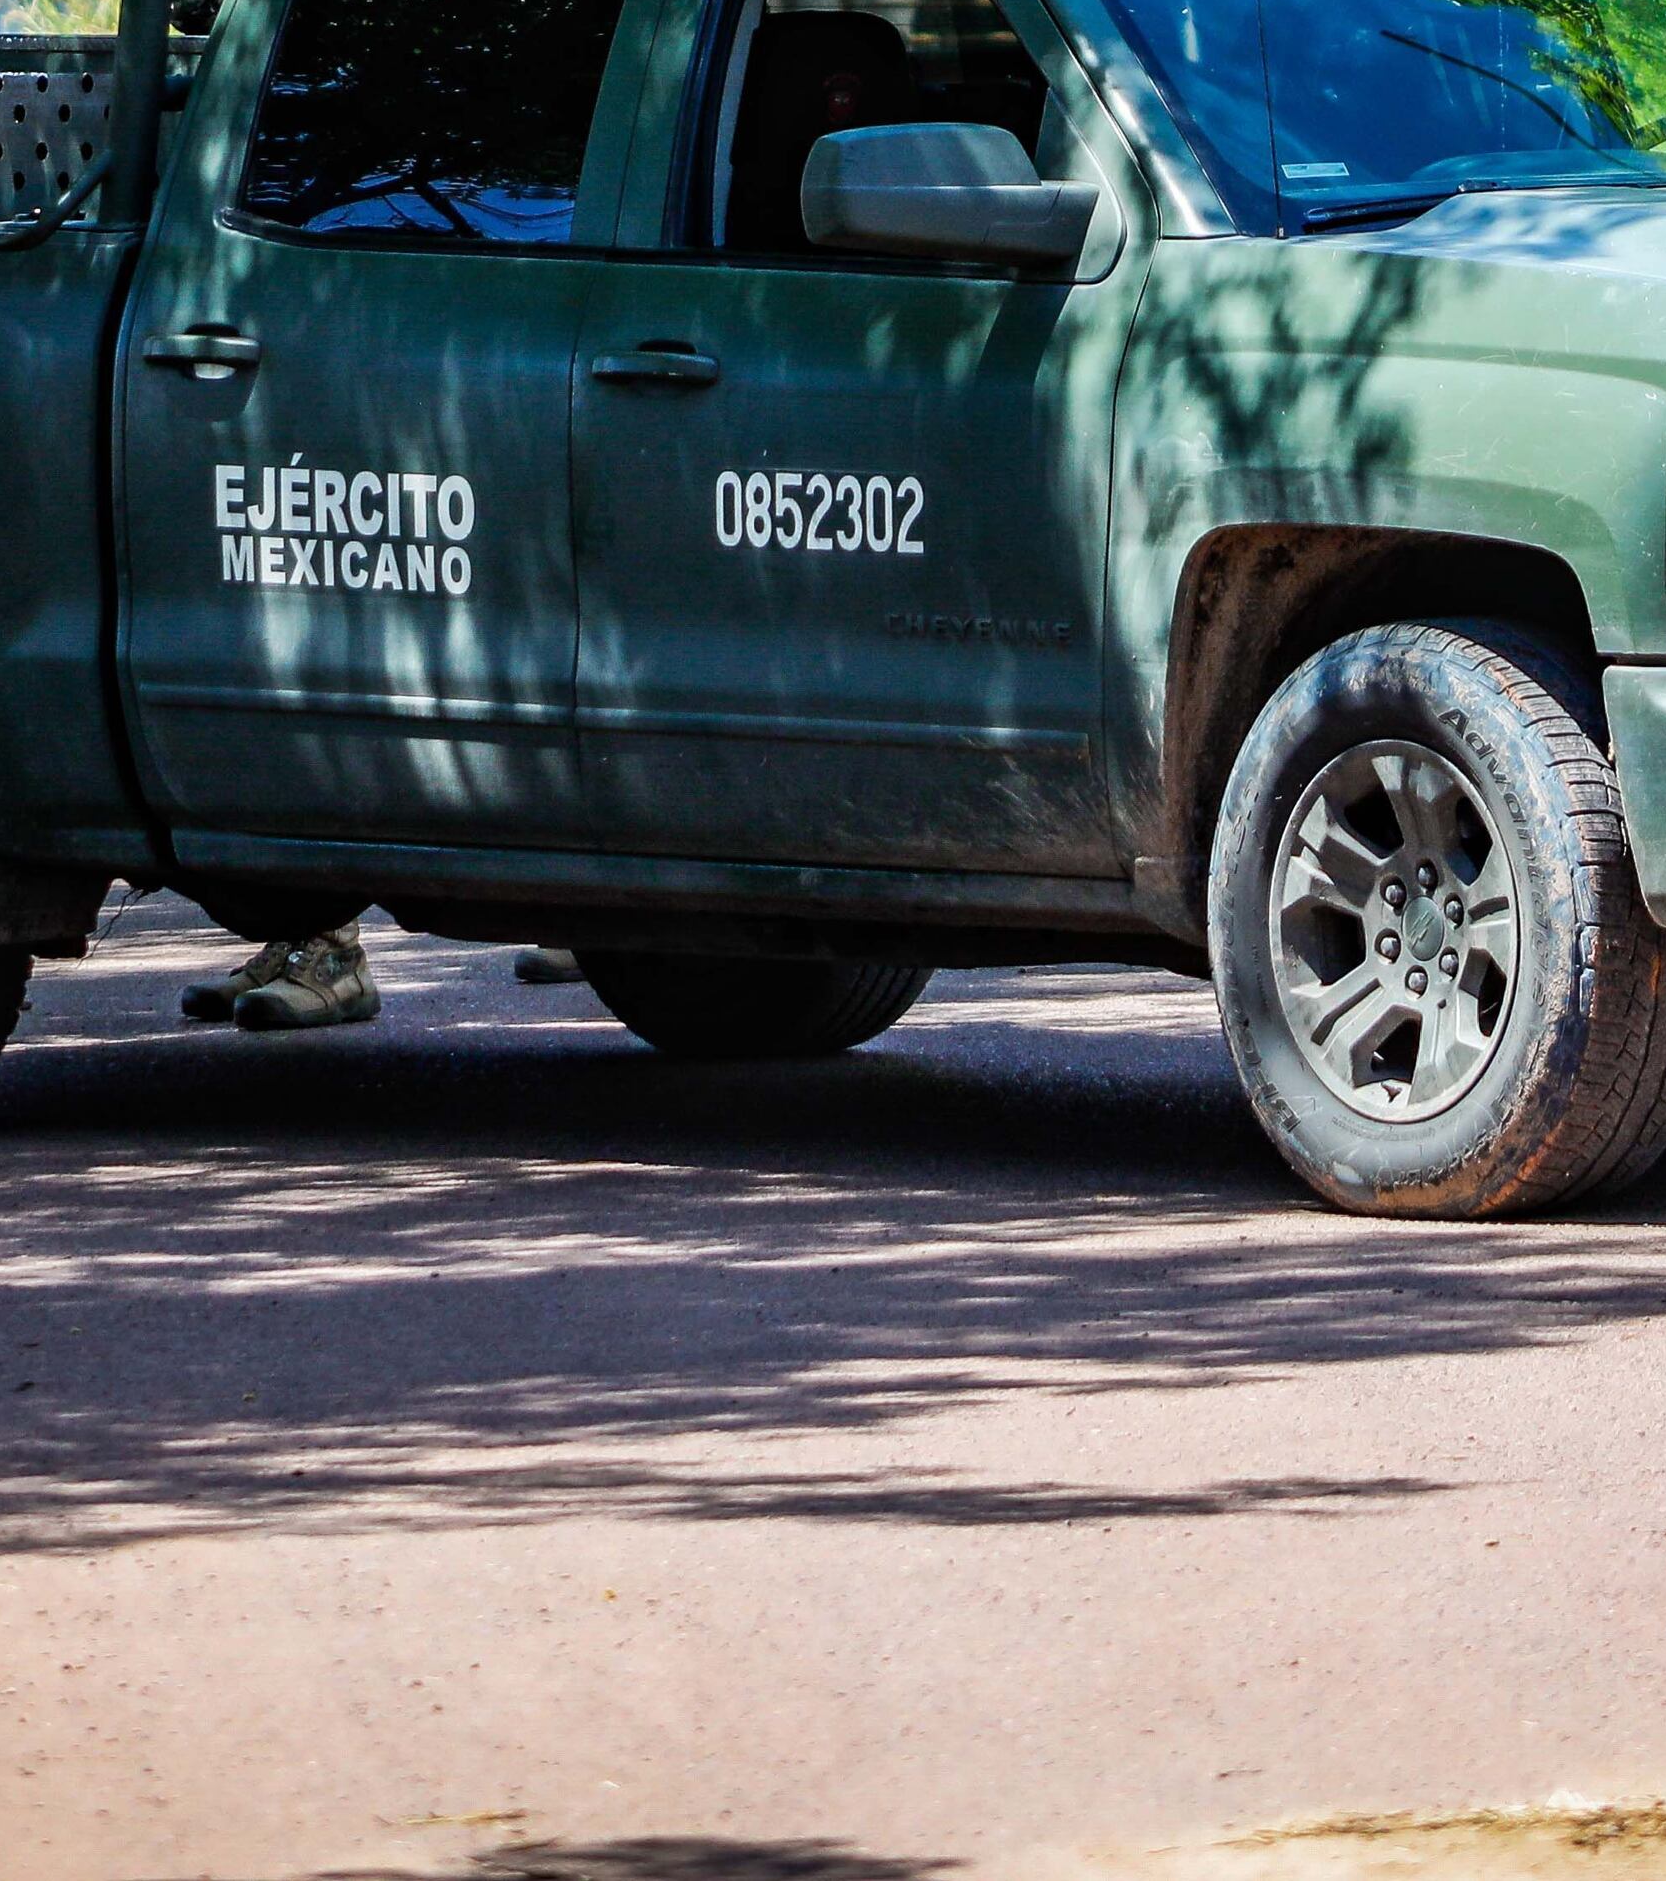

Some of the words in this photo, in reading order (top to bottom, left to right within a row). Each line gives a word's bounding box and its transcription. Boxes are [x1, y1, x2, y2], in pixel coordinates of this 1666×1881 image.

[215, 452, 475, 541] EJÉRCITO
[715, 470, 924, 554] 0852302
[221, 534, 472, 595] MEXICANO
[885, 613, 1073, 645] CHEYENNE
